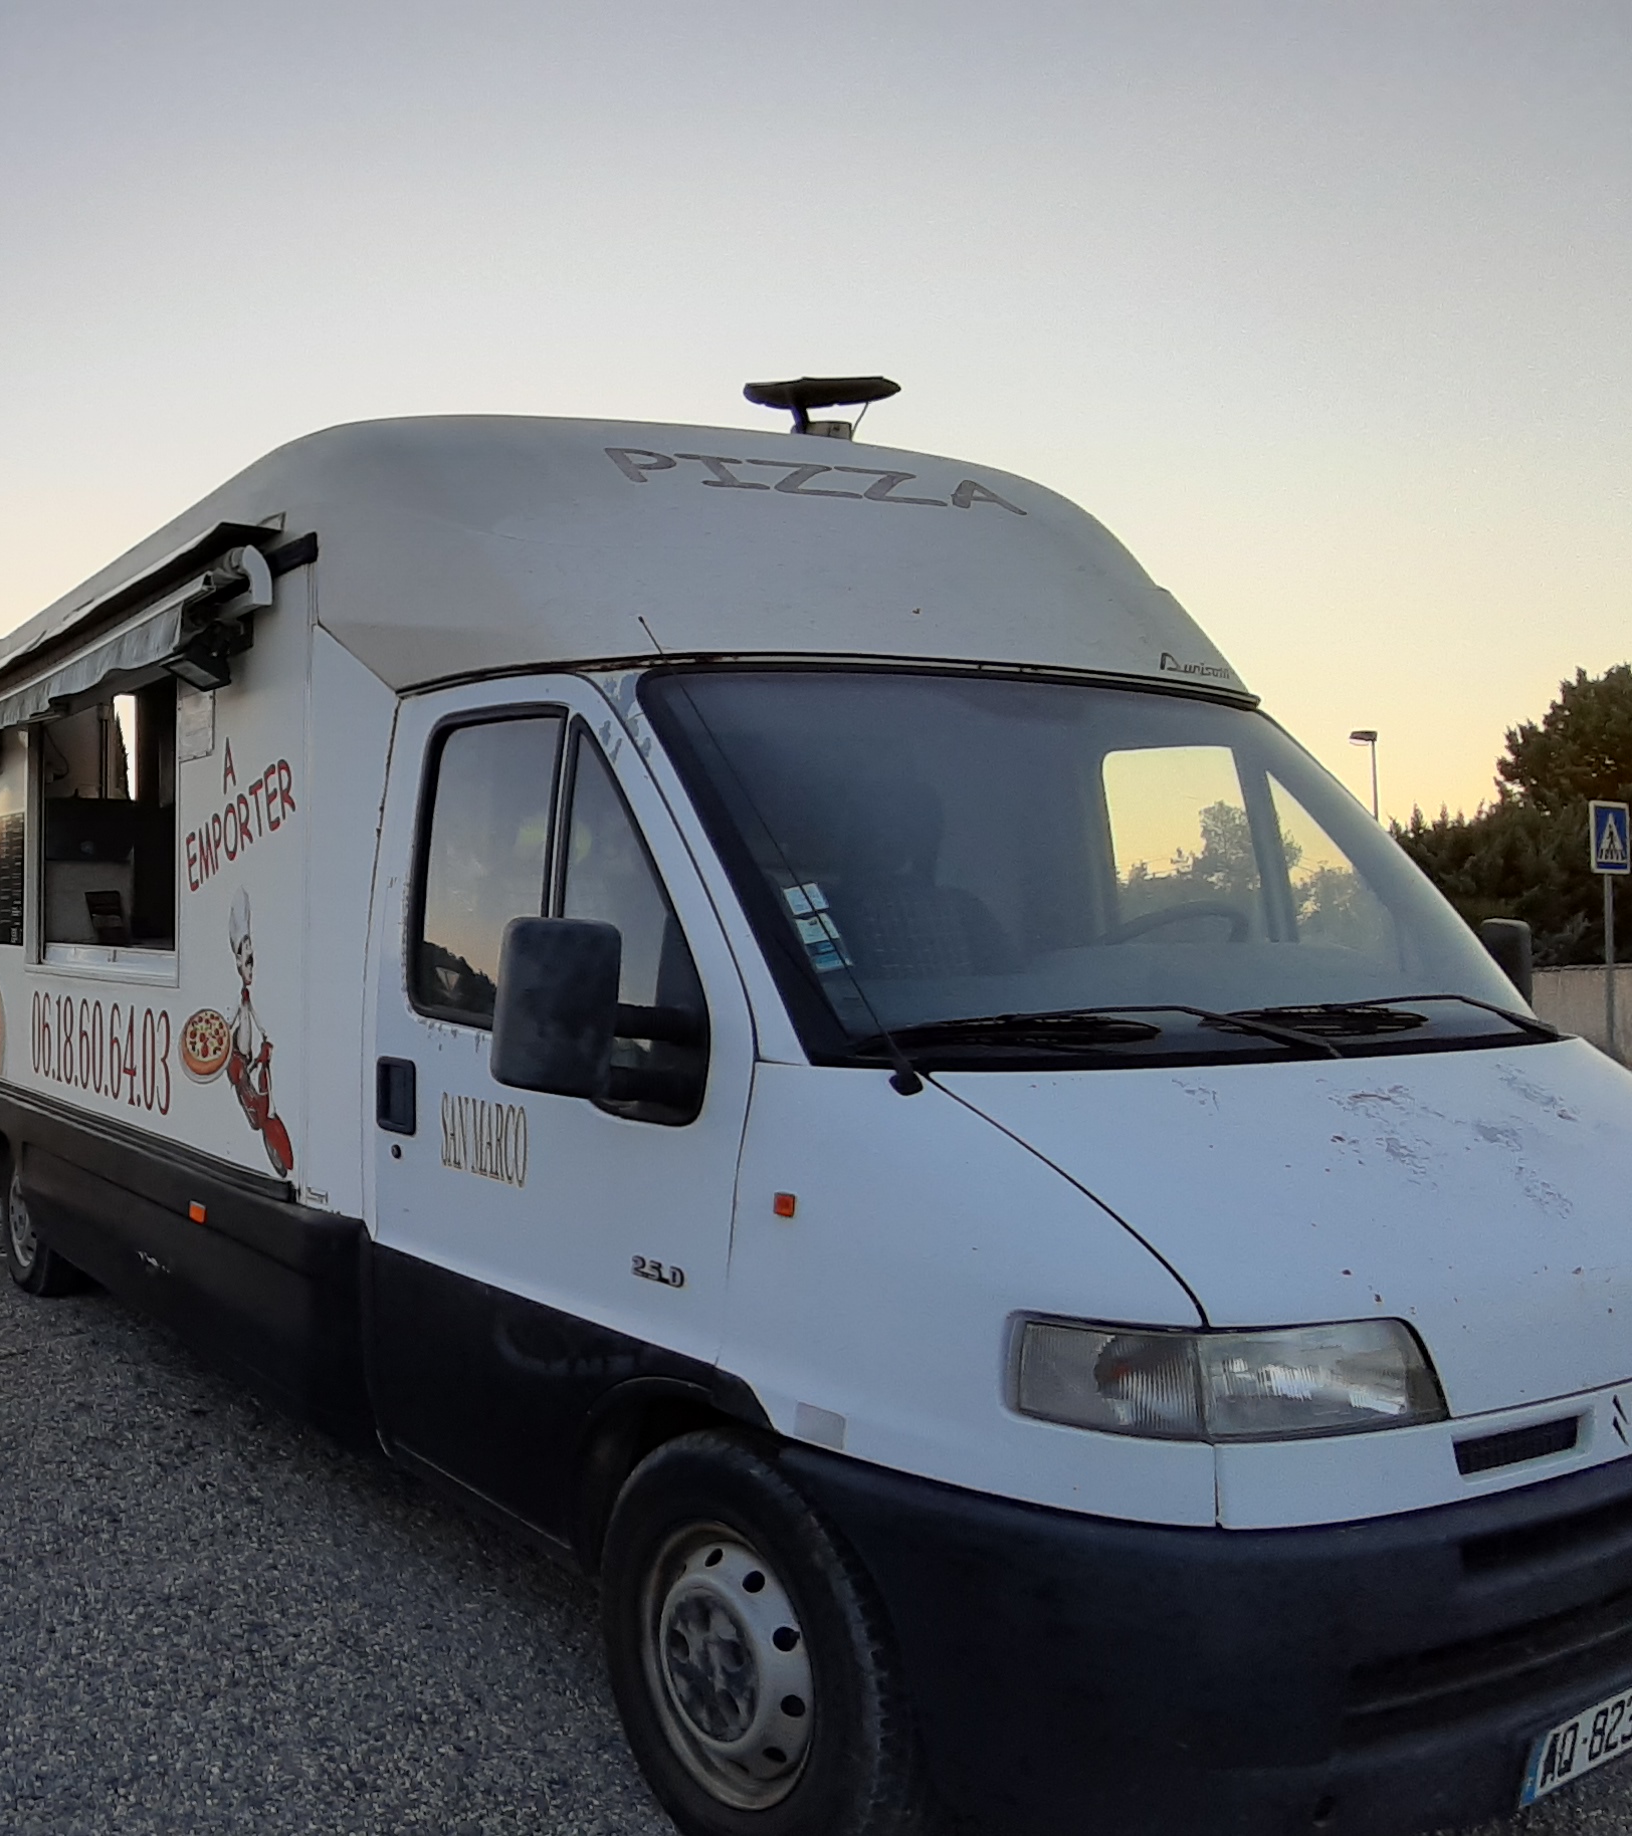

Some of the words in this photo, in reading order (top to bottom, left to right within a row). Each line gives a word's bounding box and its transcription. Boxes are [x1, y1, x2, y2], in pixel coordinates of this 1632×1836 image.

[604, 446, 1028, 517] PIZZA
[223, 736, 237, 795] A
[185, 758, 297, 892] EMPORTER
[31, 990, 171, 1116] 06.18.60.64.03
[441, 1091, 469, 1171] SAN
[471, 1097, 527, 1188] MARCO
